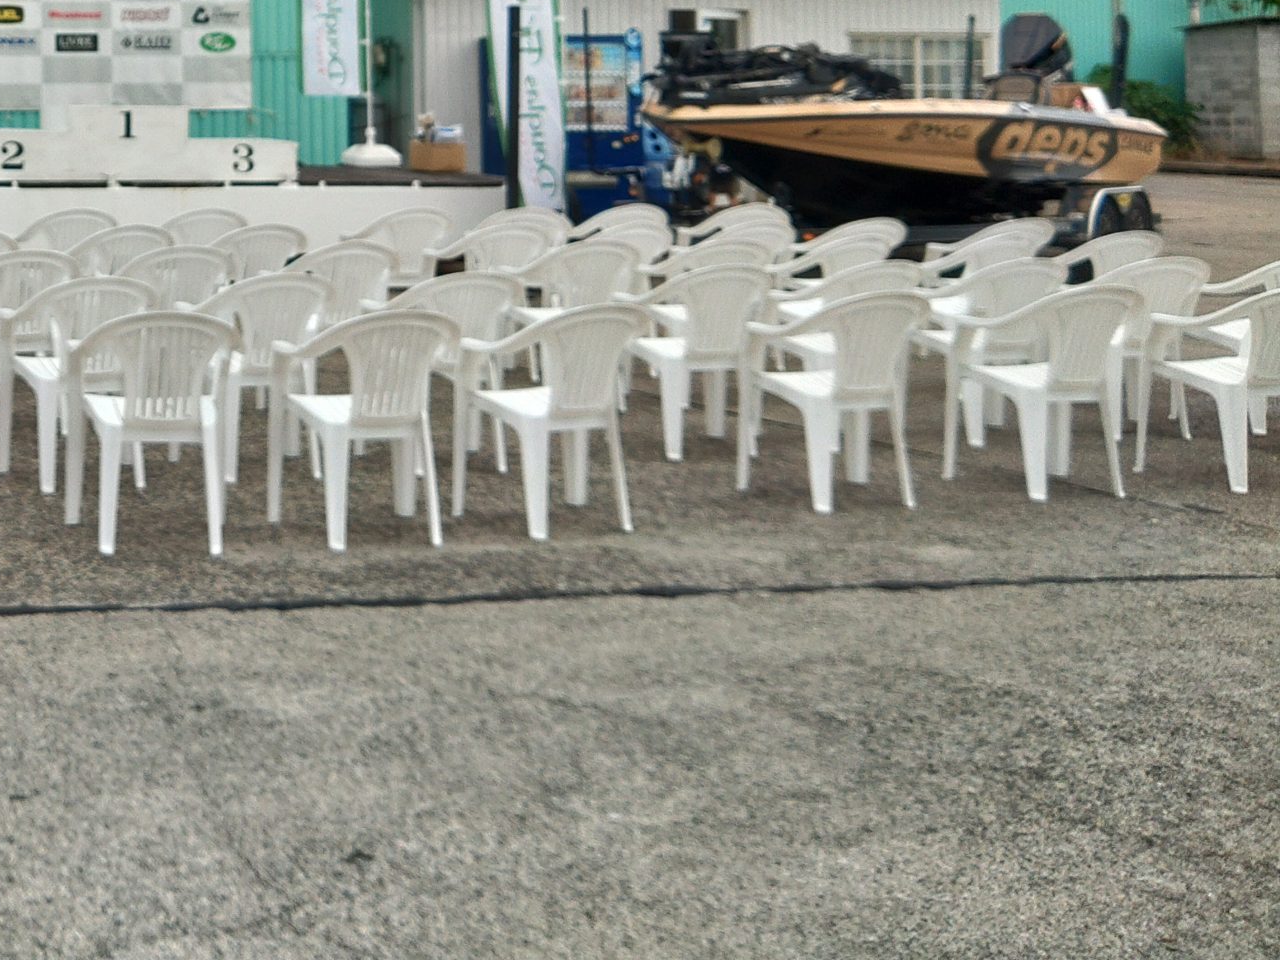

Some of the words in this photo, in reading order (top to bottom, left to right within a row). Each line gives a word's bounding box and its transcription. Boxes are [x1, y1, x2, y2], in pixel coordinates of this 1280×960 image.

[120, 109, 136, 139] 1
[0, 139, 25, 170] 2
[232, 142, 254, 173] 3
[991, 120, 1114, 175] deps
